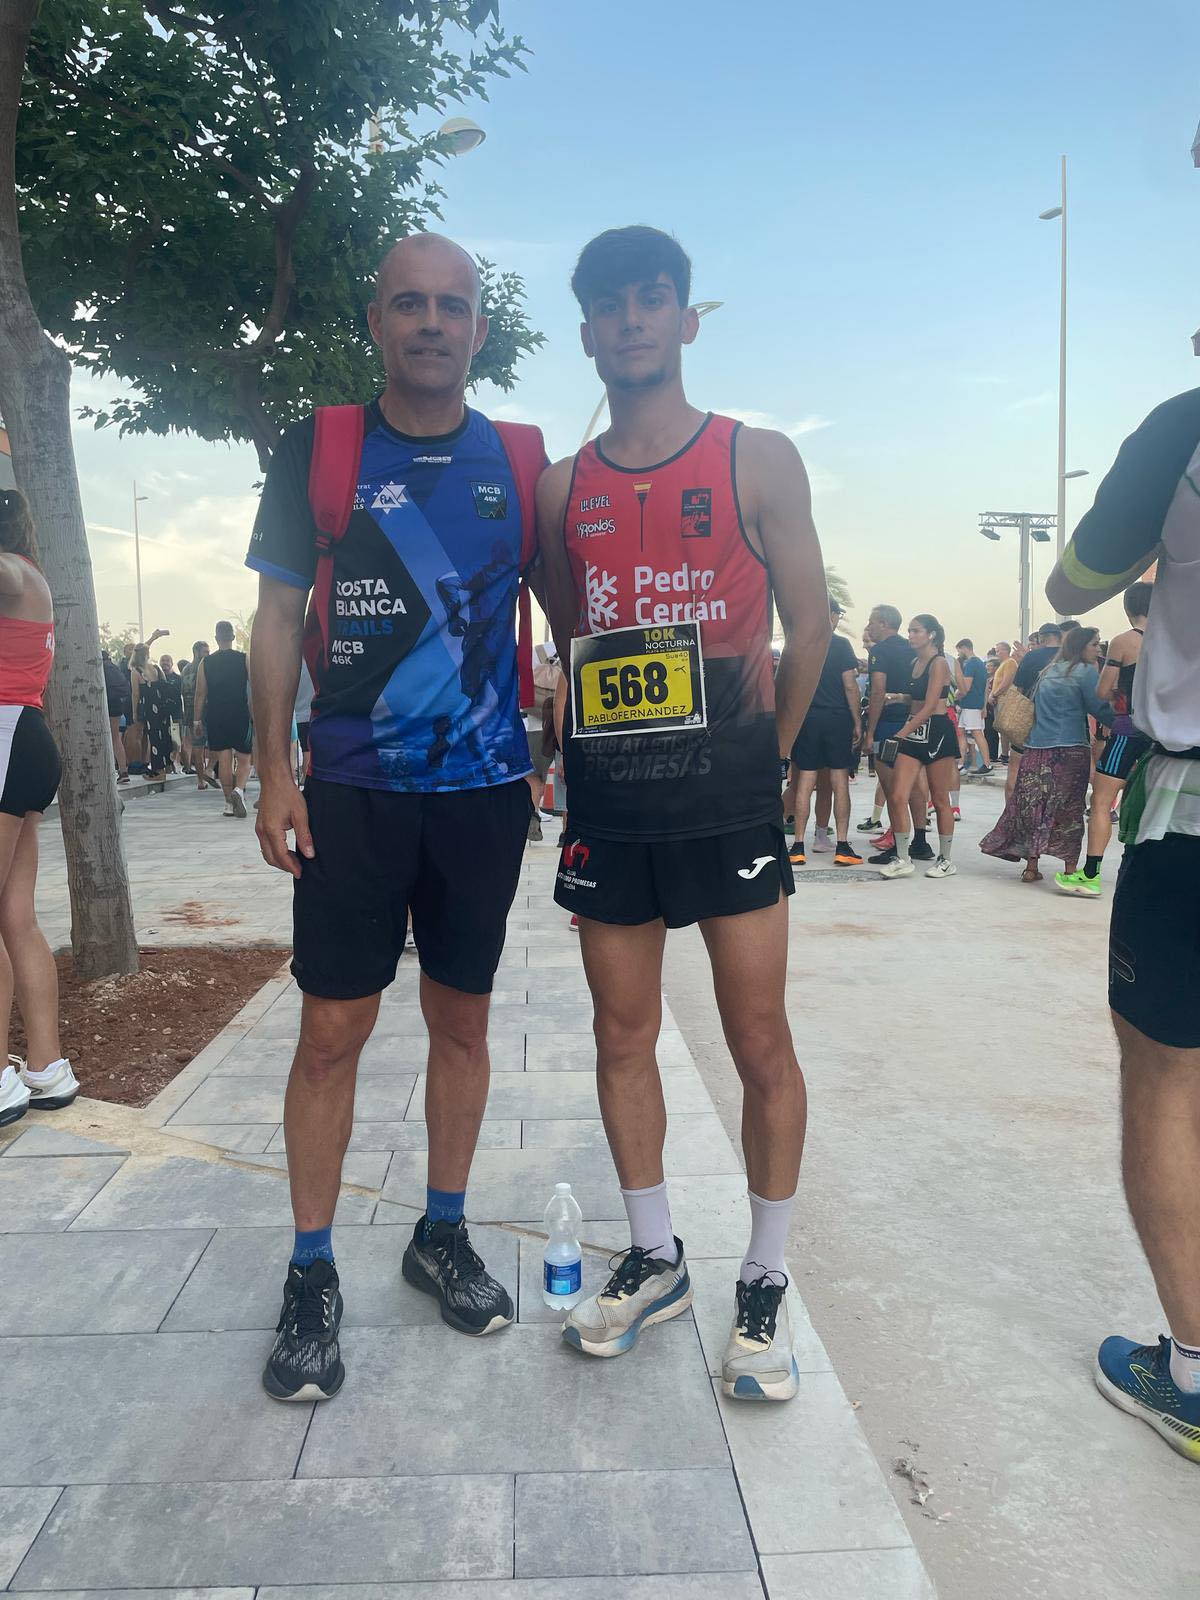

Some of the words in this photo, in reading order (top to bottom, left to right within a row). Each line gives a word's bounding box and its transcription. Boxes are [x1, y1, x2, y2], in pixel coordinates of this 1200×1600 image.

[478, 486, 501, 495] MCB
[634, 562, 715, 594] Pedro
[335, 598, 407, 617] BLANCA
[643, 627, 676, 642] 10K
[331, 640, 365, 654] MCB
[645, 638, 696, 650] NOCTURNA
[331, 655, 352, 666] 46K
[598, 661, 669, 710] 568
[588, 705, 688, 724] PABLOFERNANDEZ
